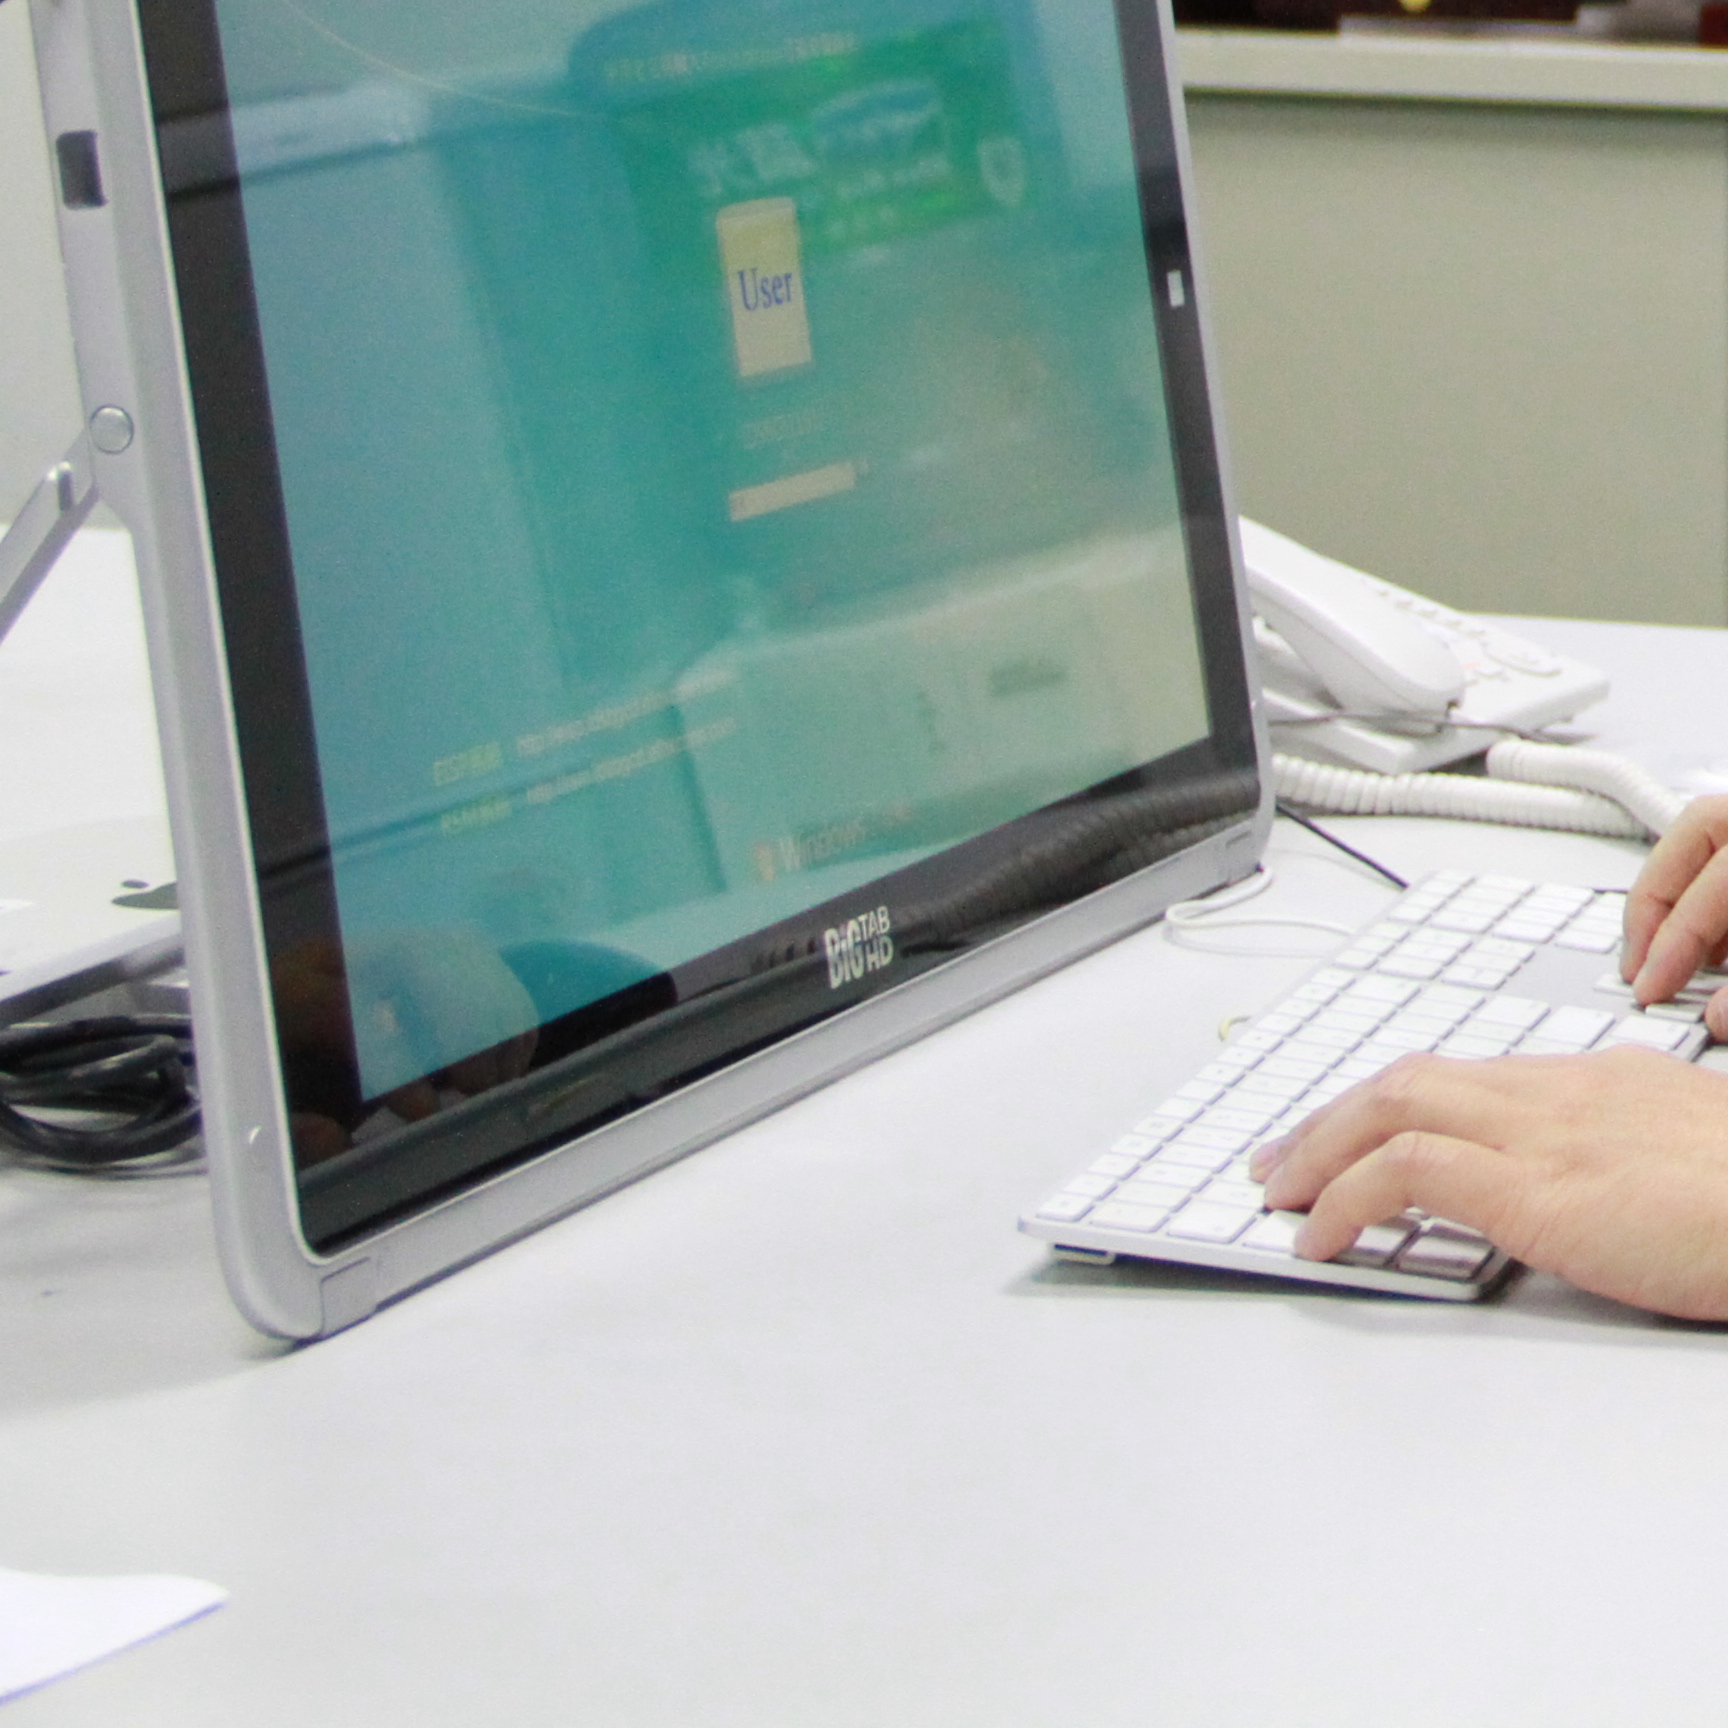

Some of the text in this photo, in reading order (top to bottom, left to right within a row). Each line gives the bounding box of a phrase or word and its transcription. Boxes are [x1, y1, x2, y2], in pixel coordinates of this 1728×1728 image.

[737, 267, 795, 313] User
[857, 904, 891, 940] TAB
[866, 935, 894, 972] HD
